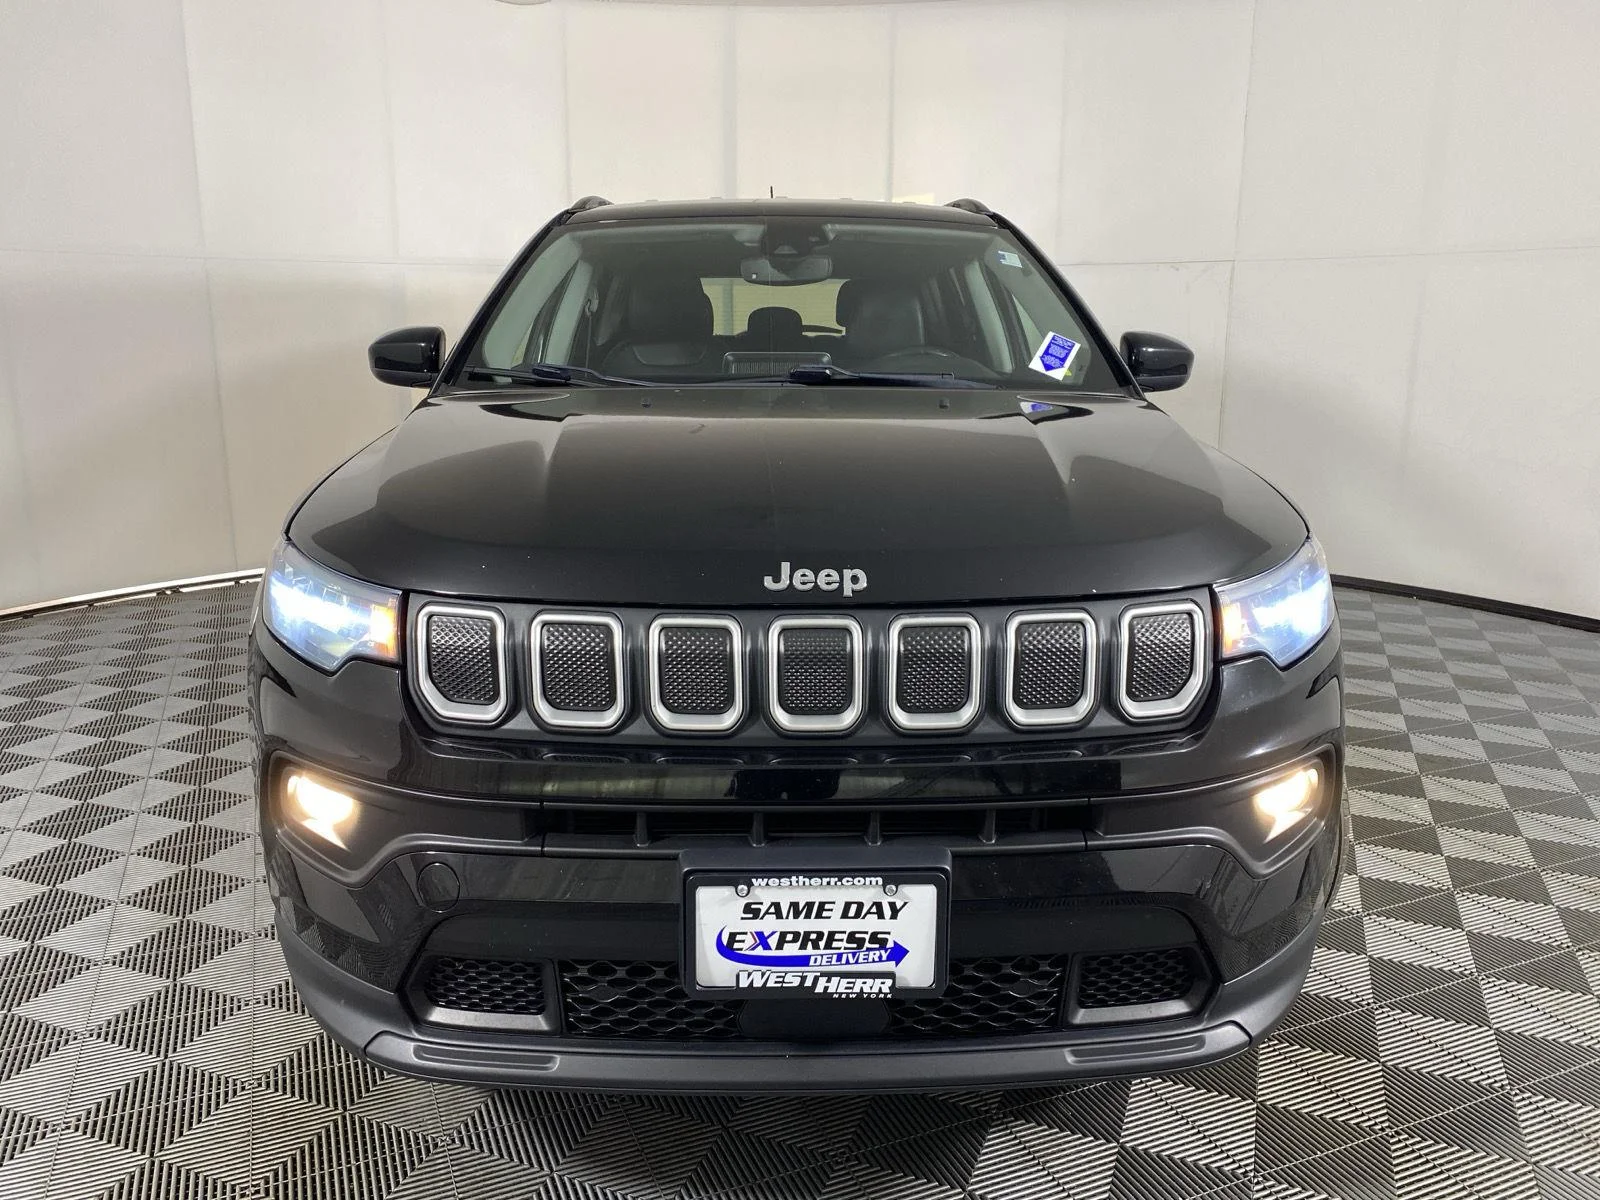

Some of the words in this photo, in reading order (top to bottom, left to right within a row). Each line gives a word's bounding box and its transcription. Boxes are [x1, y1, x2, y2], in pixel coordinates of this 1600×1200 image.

[763, 561, 868, 598] Jeep
[751, 875, 883, 887] westherr.com
[740, 901, 836, 920] SAME
[840, 901, 909, 920] DAY
[726, 930, 891, 951] EXPRESS
[808, 949, 891, 967] DELIVERY
